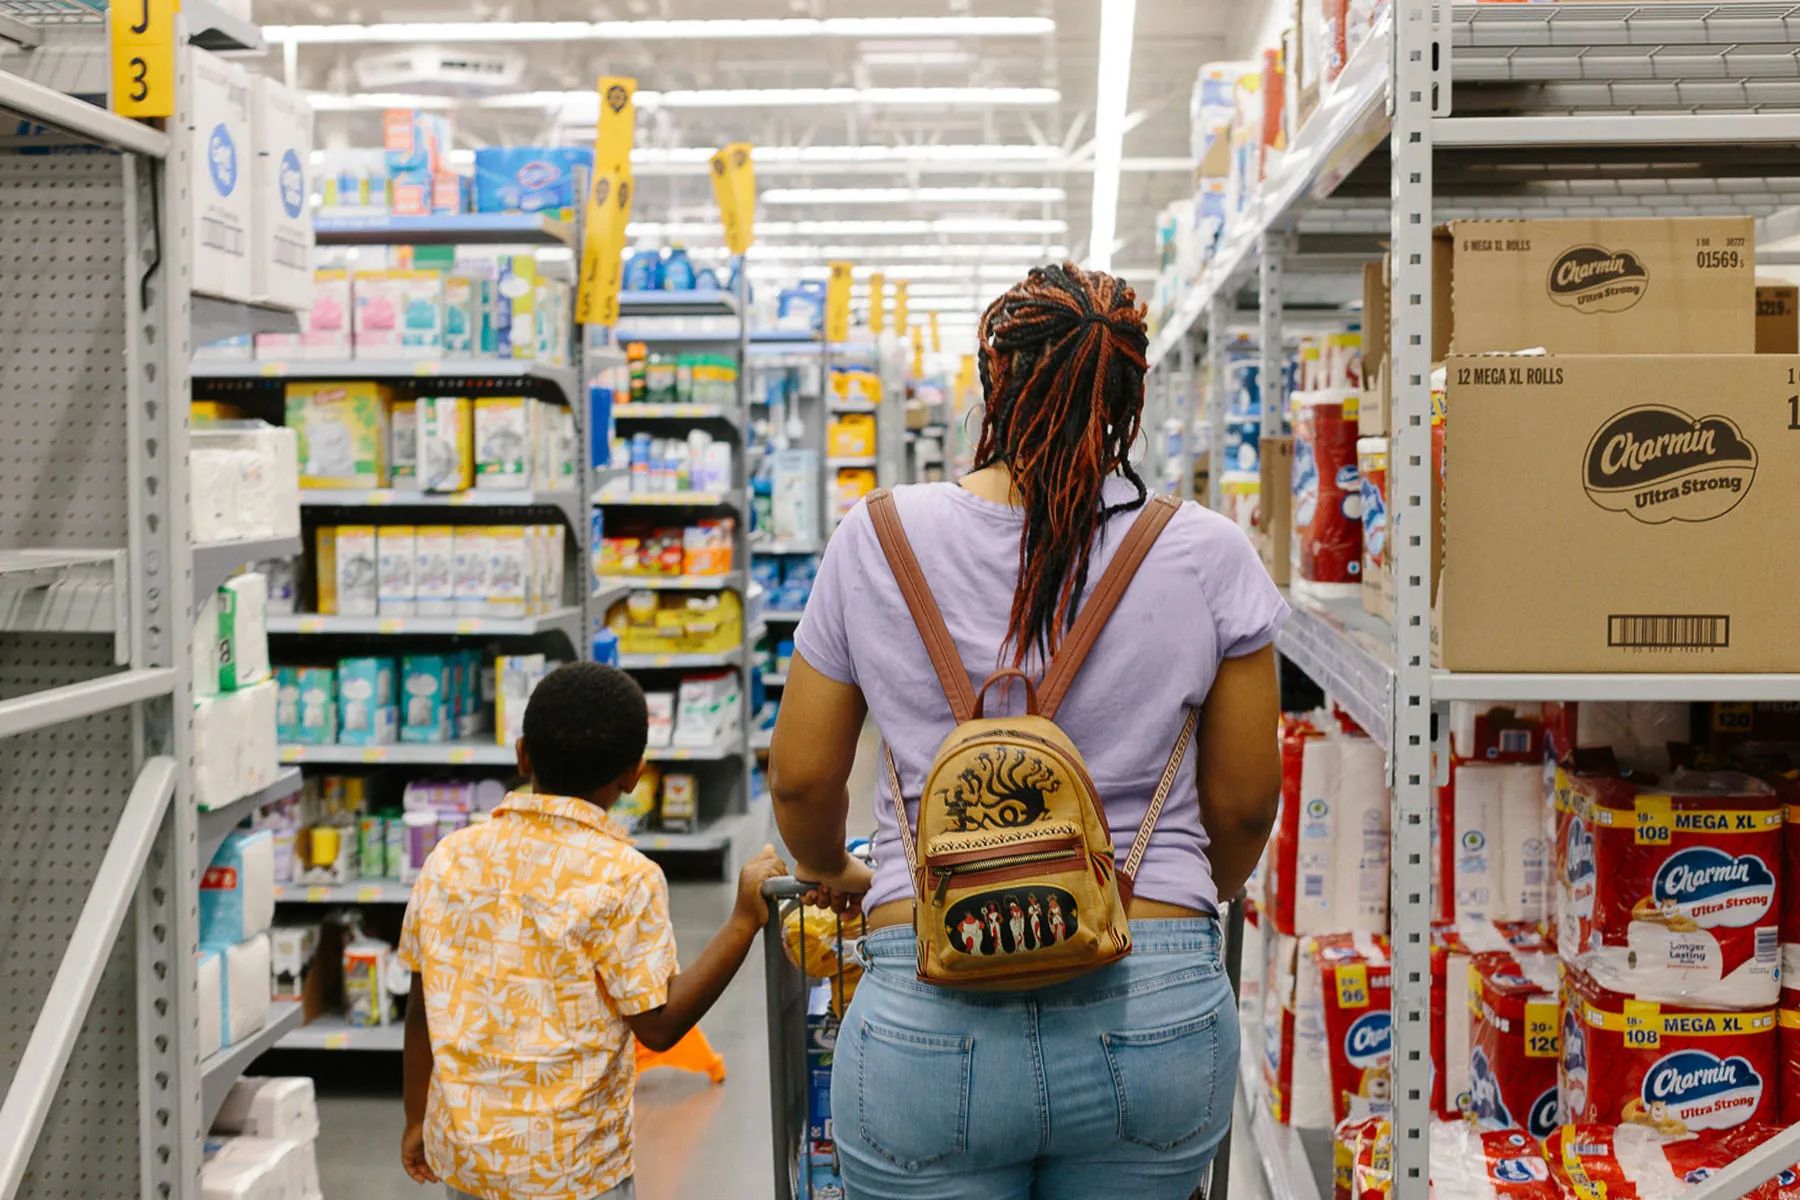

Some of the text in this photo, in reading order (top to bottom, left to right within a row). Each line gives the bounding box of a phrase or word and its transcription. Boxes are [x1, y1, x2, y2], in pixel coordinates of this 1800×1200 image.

[129, 57, 148, 102] 3
[1463, 240, 1531, 252] 6 MEGA XL ROLLS
[1697, 251, 1739, 268] 01569
[1557, 255, 1625, 286] Charmin
[1577, 285, 1640, 305] Ultra Strong
[1458, 367, 1564, 384] 12 MEGA XL ROLLS
[1601, 422, 1717, 476] Charmin
[1634, 476, 1743, 508] Ultra Strong
[1675, 814, 1756, 829] MEGA XL
[1637, 826, 1669, 840] 108
[1665, 859, 1749, 895] Charmin
[1691, 896, 1768, 918] Ultra Strong
[1670, 941, 1705, 952] Longer
[1669, 951, 1706, 961] Lasting
[1342, 990, 1365, 1003] 96
[1664, 1018, 1743, 1032] MEGA XL
[1627, 1030, 1658, 1043] 108
[1653, 1060, 1737, 1098] Charmin
[1680, 1095, 1755, 1120] Ultra Strong
